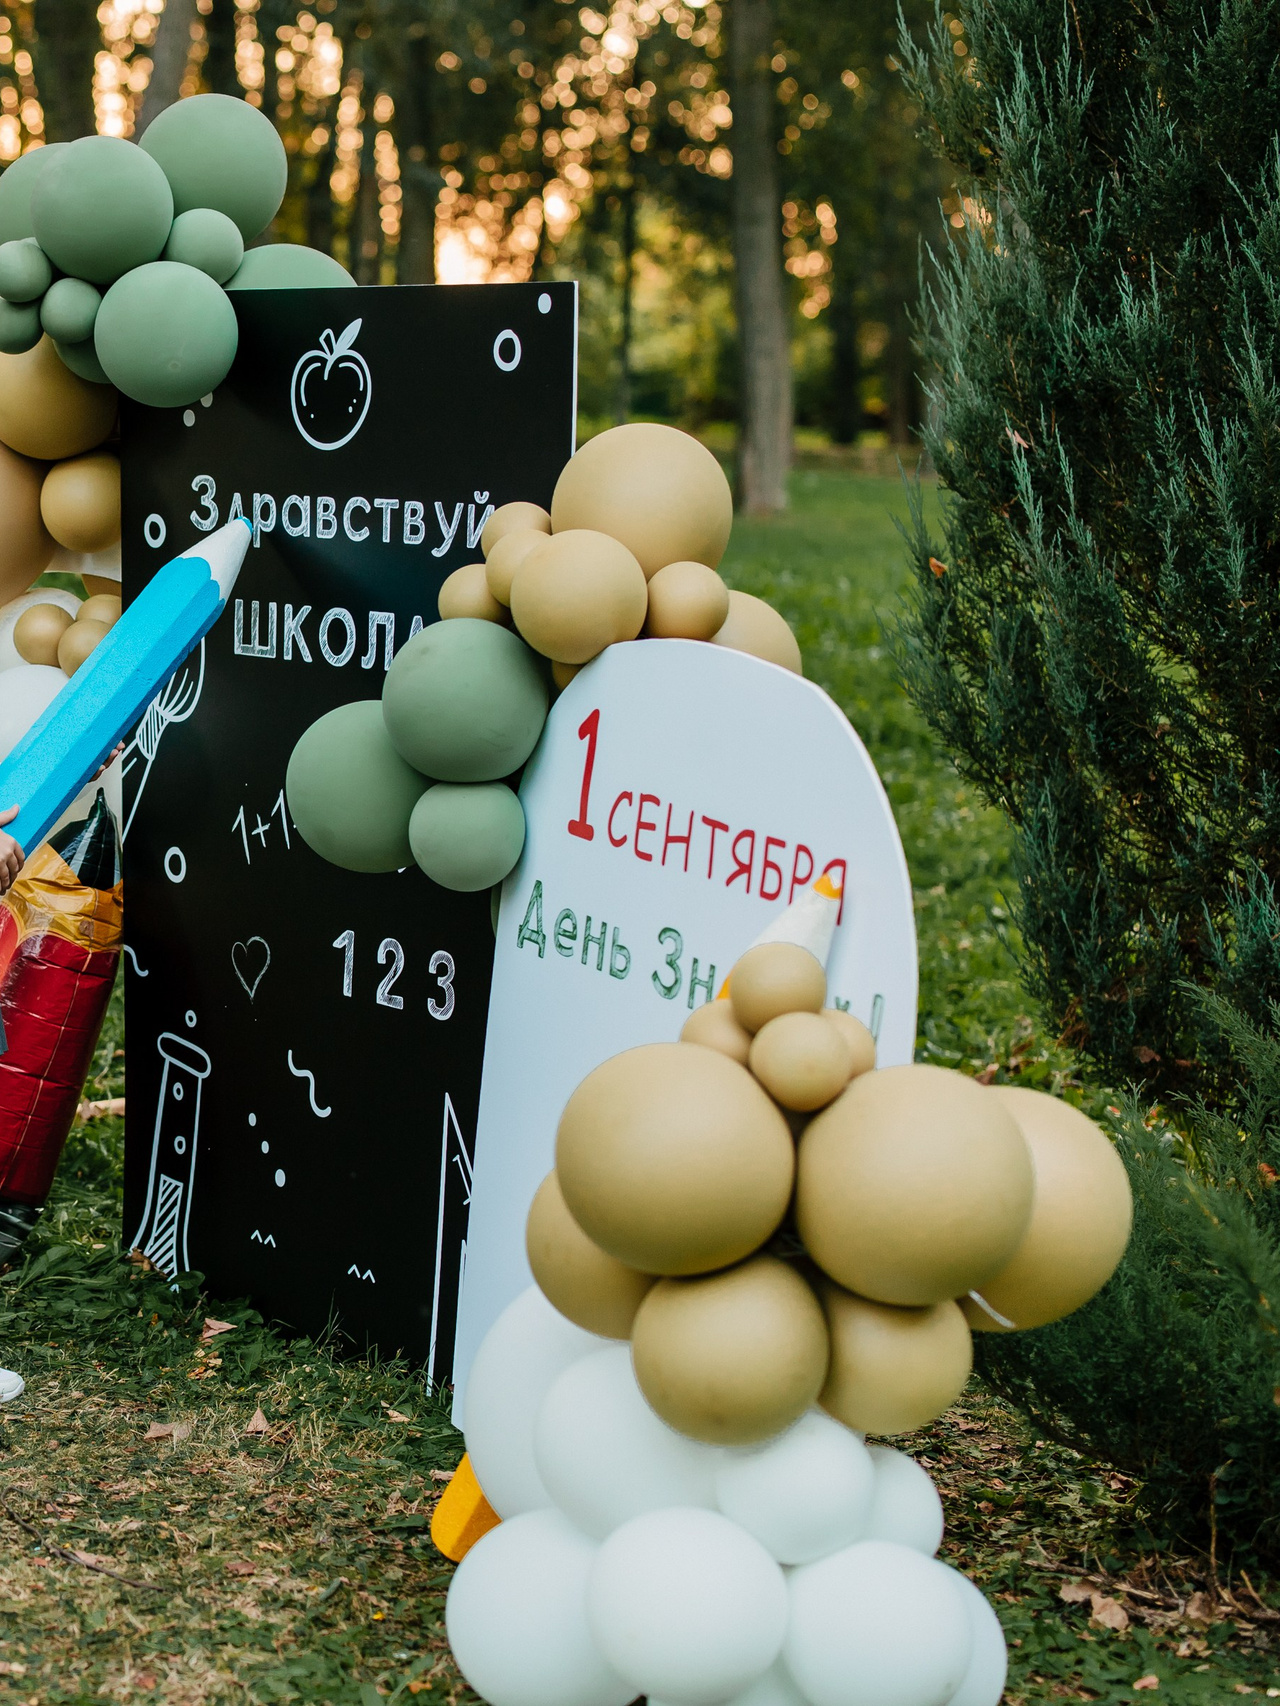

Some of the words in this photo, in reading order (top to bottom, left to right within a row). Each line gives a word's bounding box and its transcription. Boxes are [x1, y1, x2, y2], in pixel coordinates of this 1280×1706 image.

[235, 599, 425, 670] ШКОЛ
[568, 709, 600, 841] 1
[517, 880, 631, 979] День
